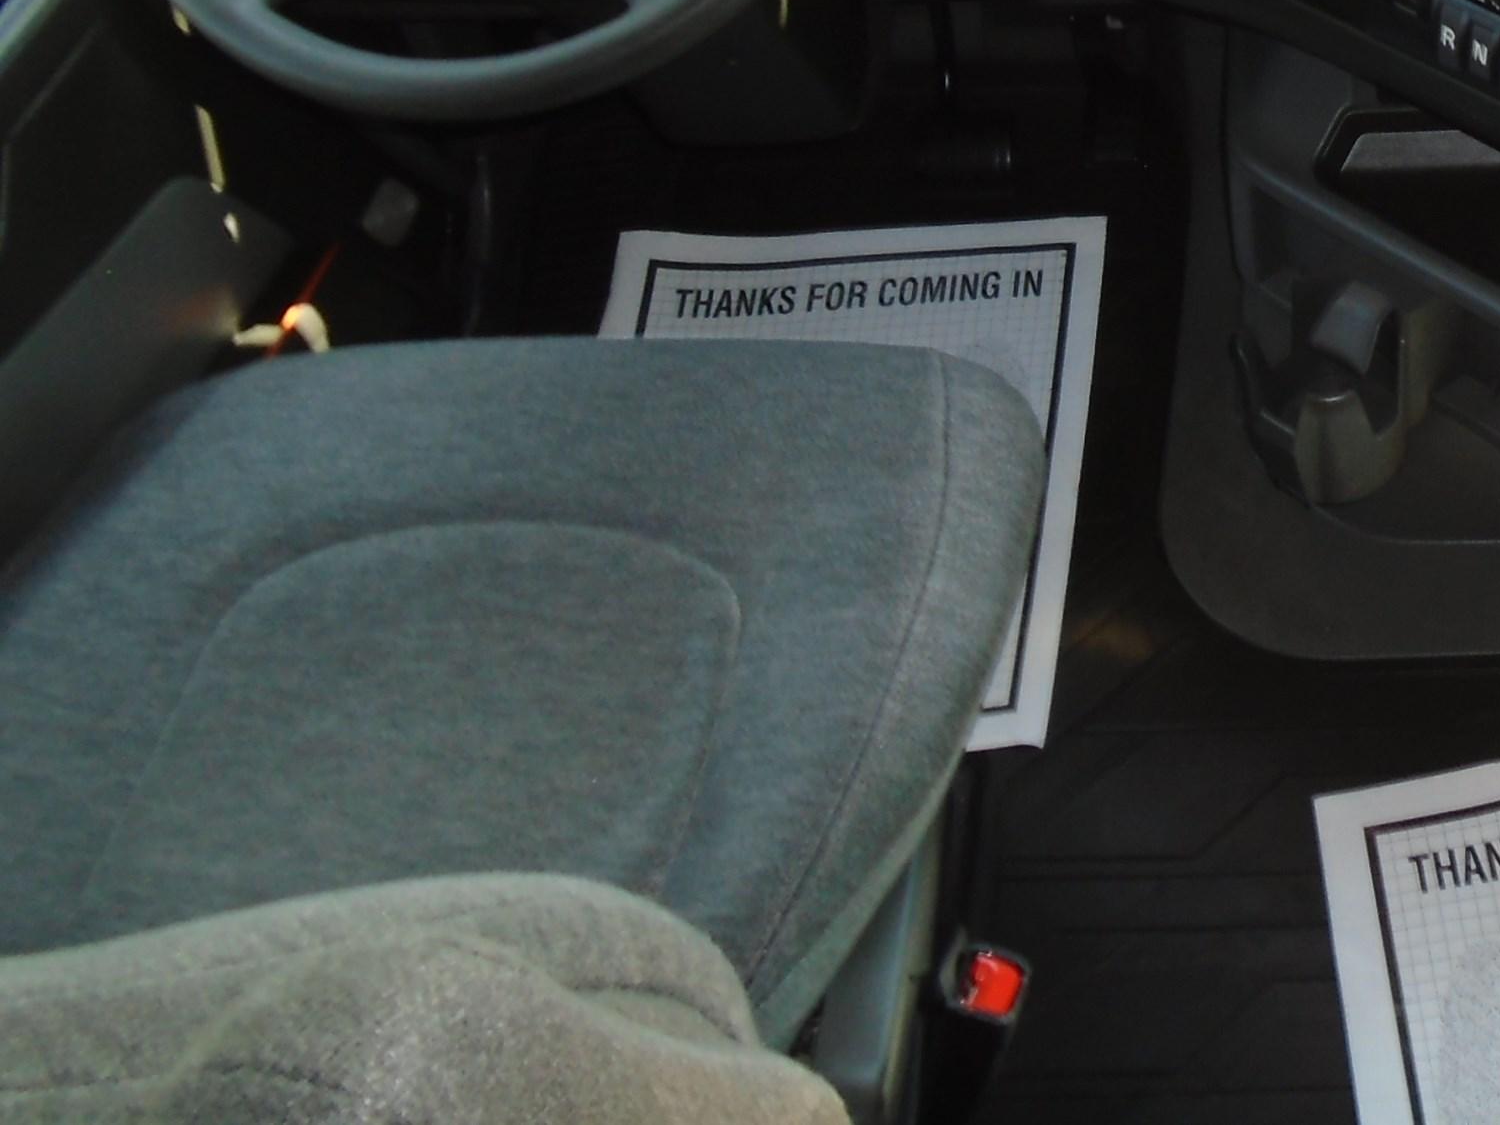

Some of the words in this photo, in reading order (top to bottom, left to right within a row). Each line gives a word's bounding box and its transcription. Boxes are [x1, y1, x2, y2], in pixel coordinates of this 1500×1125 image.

[1440, 25, 1456, 50] R
[1472, 39, 1488, 66] N
[675, 286, 797, 320] THANKS
[805, 281, 867, 313] FOR
[878, 272, 1001, 306] COMING
[1011, 269, 1044, 298] IN
